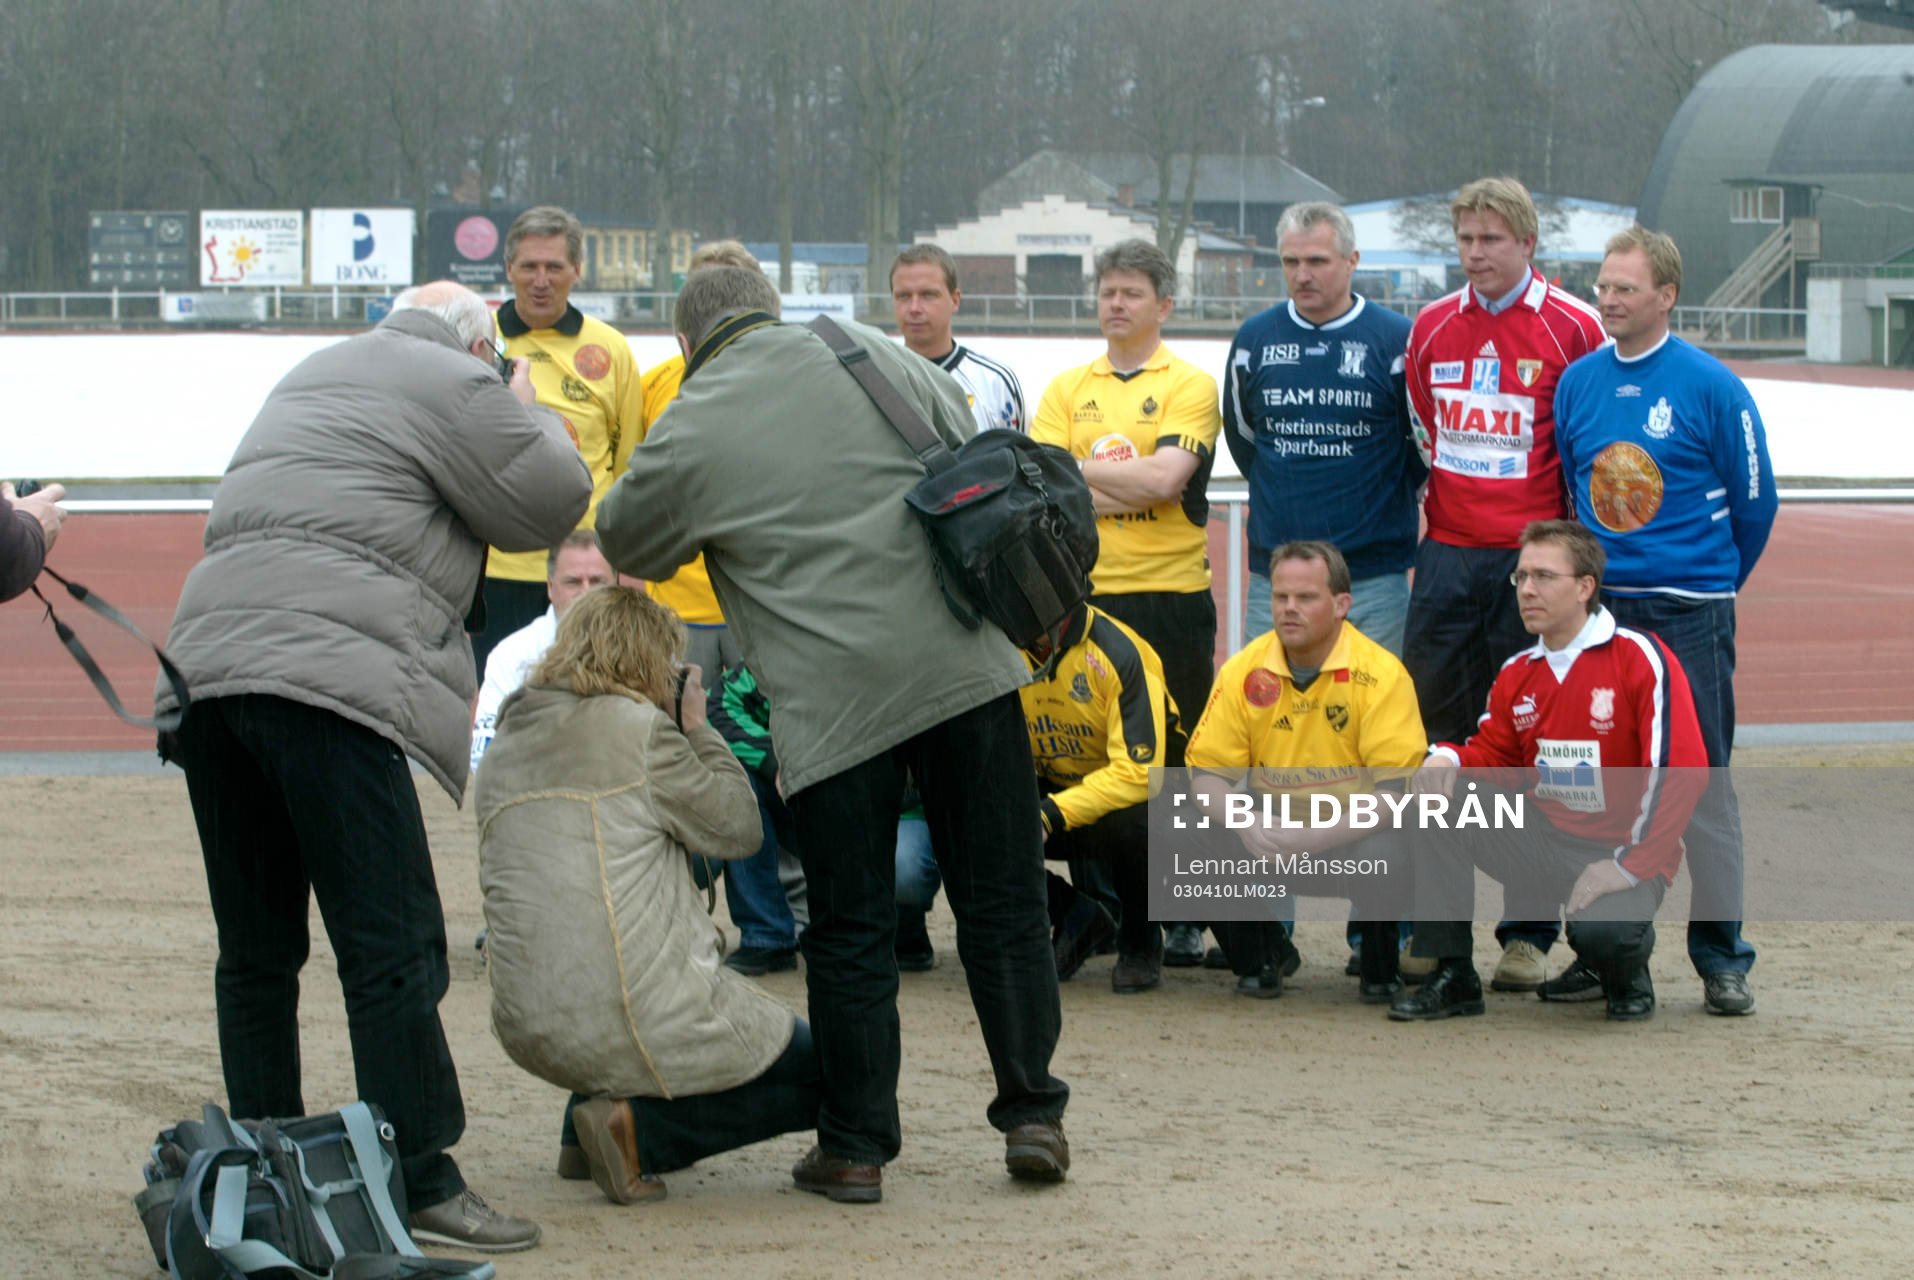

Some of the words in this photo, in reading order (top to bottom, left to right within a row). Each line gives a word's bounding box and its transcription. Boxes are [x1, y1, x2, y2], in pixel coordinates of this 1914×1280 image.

[206, 217, 298, 230] KRISTIANSTAD
[1262, 343, 1300, 361] HSB
[1262, 388, 1315, 406] TEAM
[1319, 388, 1373, 409] SPORTIA
[1265, 416, 1372, 437] Kristianstads
[1438, 398, 1521, 436] MAXI
[1273, 438, 1354, 458] Sparbank
[1439, 452, 1490, 473] ERICSSON
[1025, 714, 1095, 737] olksam
[1541, 744, 1593, 758] ALMÖHUS
